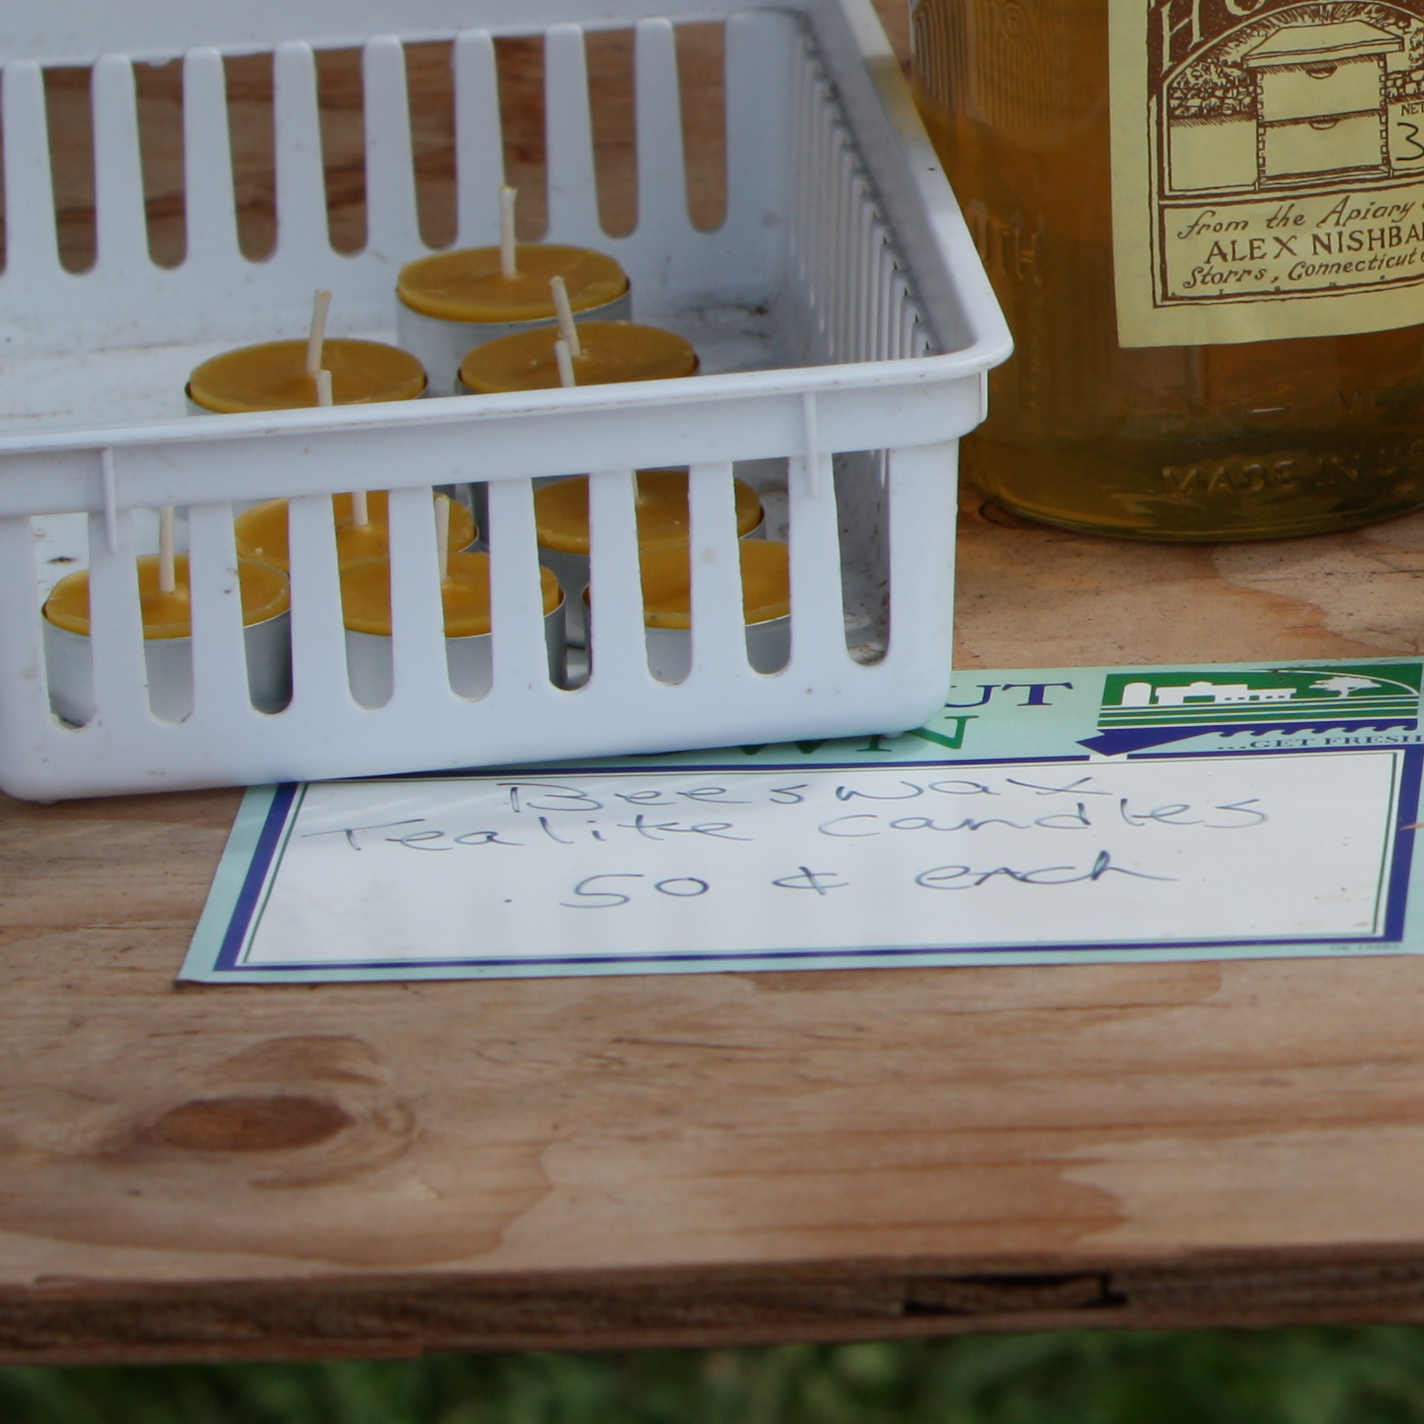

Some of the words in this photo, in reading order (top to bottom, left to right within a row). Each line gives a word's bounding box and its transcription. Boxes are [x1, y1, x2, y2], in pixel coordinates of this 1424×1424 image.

[1401, 101, 1424, 115] NET
[1177, 210, 1249, 240] from
[1266, 203, 1306, 227] the
[1317, 195, 1415, 228] Apiary
[1204, 236, 1298, 264] ALEX
[1288, 251, 1416, 281] Connecticut
[1323, 733, 1424, 746] FRESH
